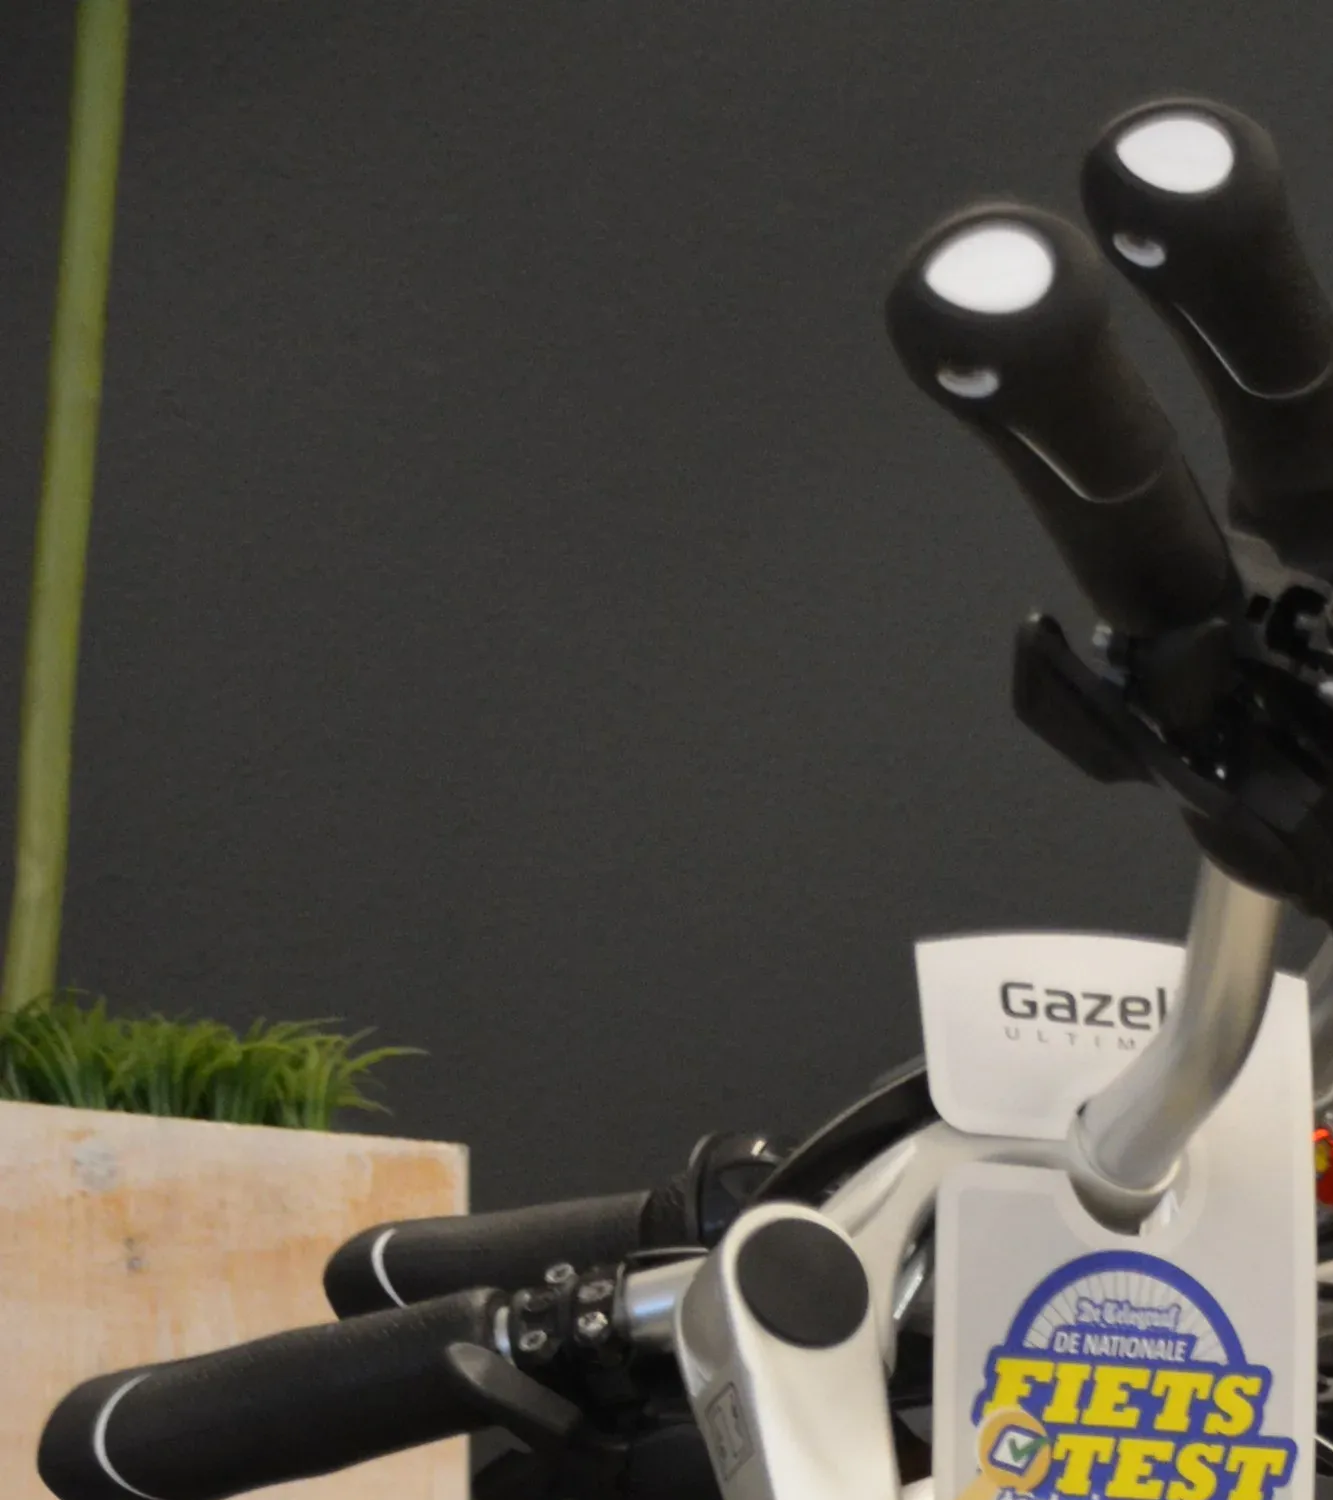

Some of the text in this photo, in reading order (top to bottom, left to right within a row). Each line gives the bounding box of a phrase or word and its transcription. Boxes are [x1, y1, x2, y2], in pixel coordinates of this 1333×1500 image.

[1000, 981, 1167, 1031] Gazel
[1003, 1026, 1137, 1051] ULTIM
[1054, 1331, 1188, 1362] DE NATIONALE
[982, 1357, 1262, 1437] FIETS
